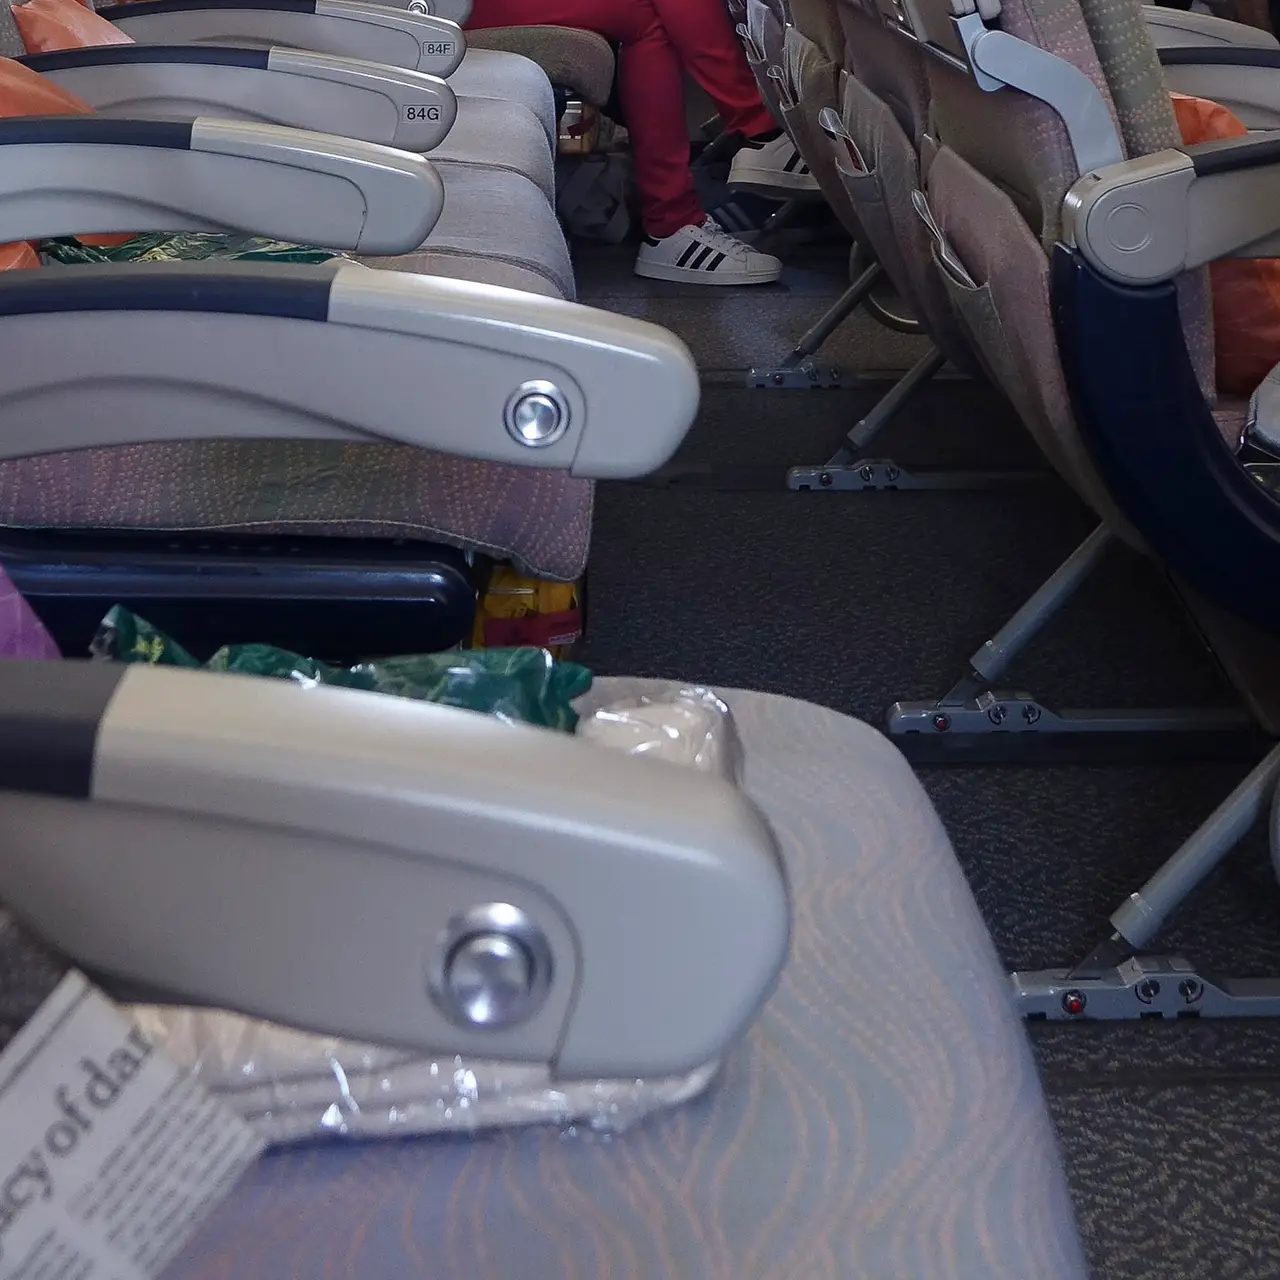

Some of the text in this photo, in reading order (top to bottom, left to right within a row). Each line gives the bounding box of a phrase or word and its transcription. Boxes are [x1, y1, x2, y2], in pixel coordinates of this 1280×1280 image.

[427, 43, 451, 54] 84F
[406, 107, 439, 121] 84G
[43, 1082, 102, 1159] of
